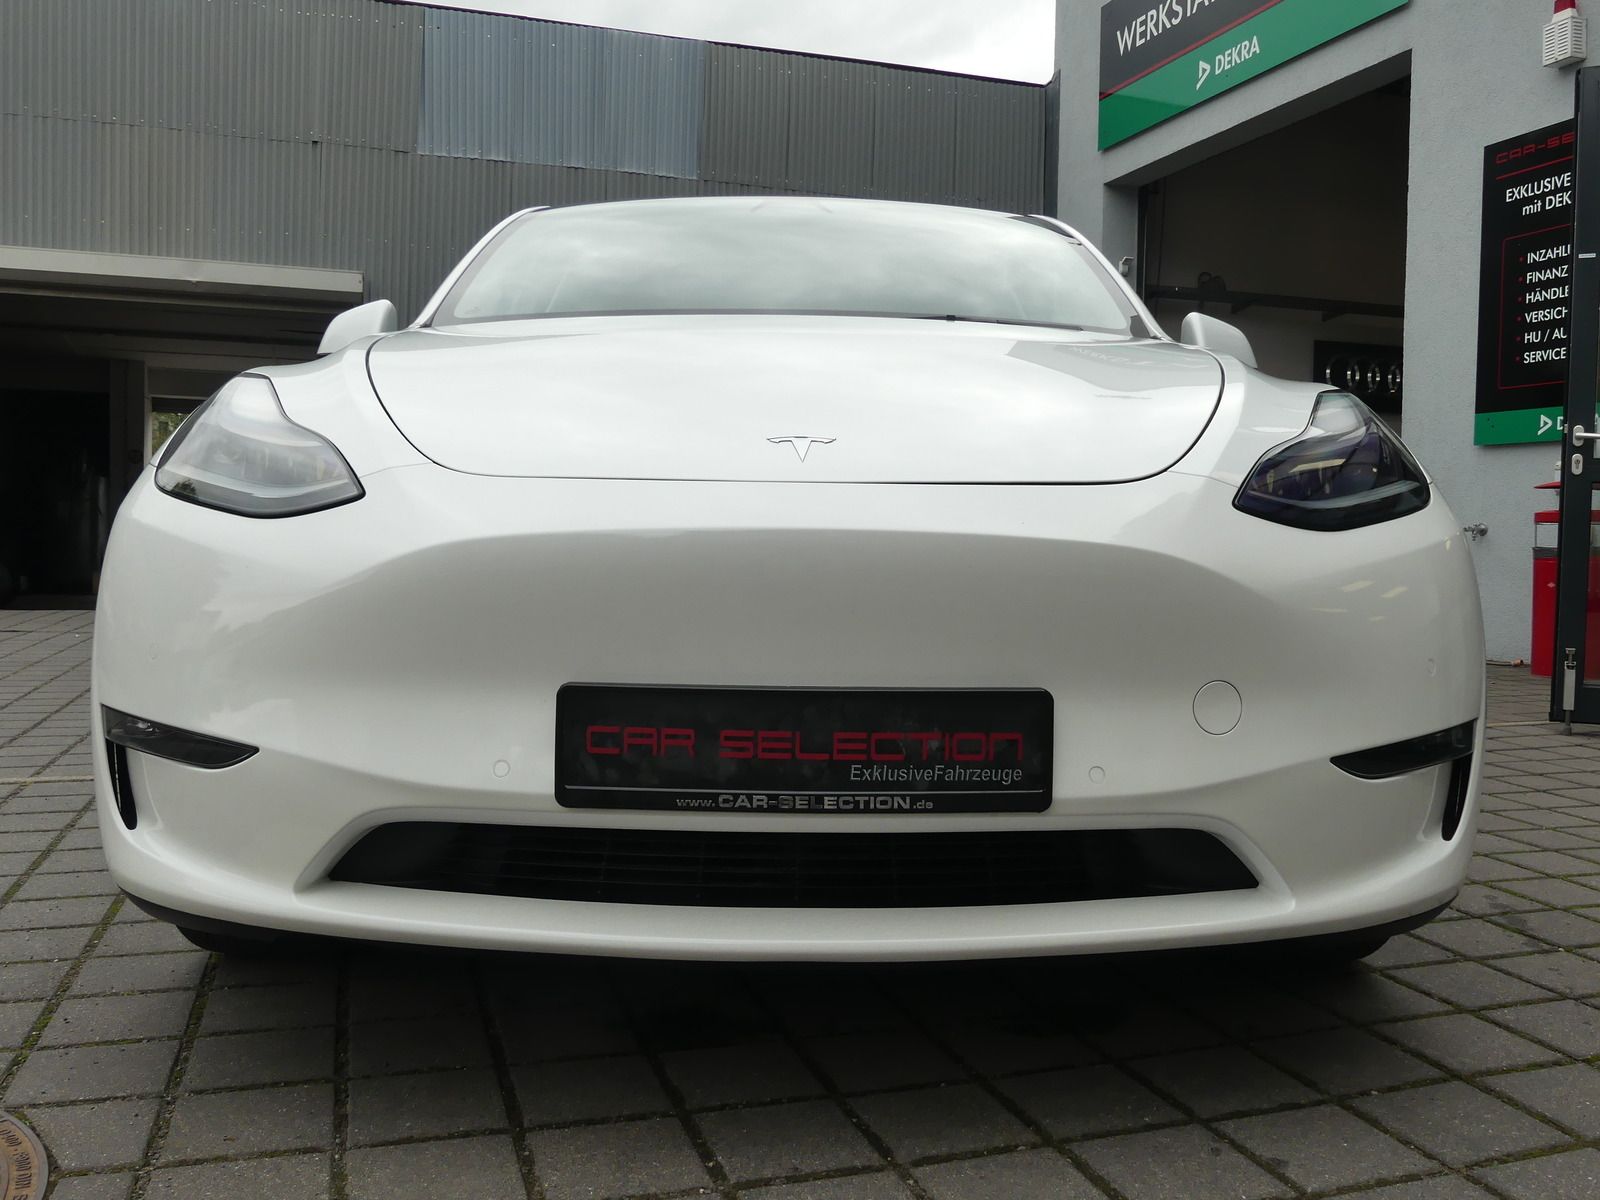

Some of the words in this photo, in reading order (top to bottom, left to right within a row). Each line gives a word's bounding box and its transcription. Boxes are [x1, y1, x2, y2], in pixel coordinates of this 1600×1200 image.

[1215, 35, 1260, 76] DEKRA
[1505, 171, 1571, 202] EXKLUSIVE
[1522, 199, 1542, 216] mit
[1545, 190, 1572, 210] DEK
[1526, 264, 1569, 284] FINANZ
[1524, 330, 1541, 344] HU
[1543, 329, 1551, 342] /
[1523, 346, 1567, 364] SERVICE
[585, 725, 695, 757] CAR
[719, 729, 1023, 761] SELECTION
[849, 764, 1023, 784] ExklusiveFahrzeuge
[676, 794, 934, 811] www.CAR-SELECTION.de
